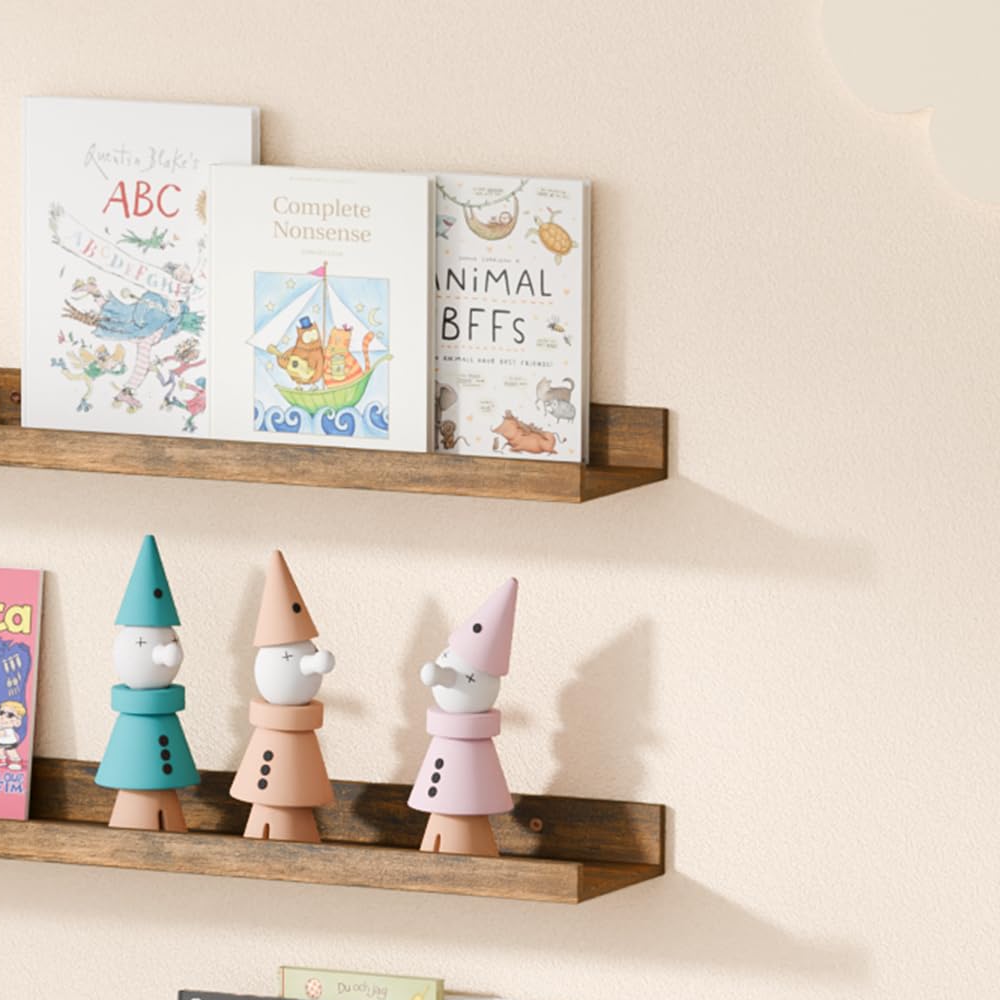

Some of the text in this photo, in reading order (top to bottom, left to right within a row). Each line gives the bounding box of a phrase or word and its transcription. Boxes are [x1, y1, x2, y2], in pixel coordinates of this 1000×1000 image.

[102, 180, 182, 219] ABC
[273, 196, 371, 221] Complete
[273, 220, 372, 242] Nonsense
[337, 982, 351, 994] Du
